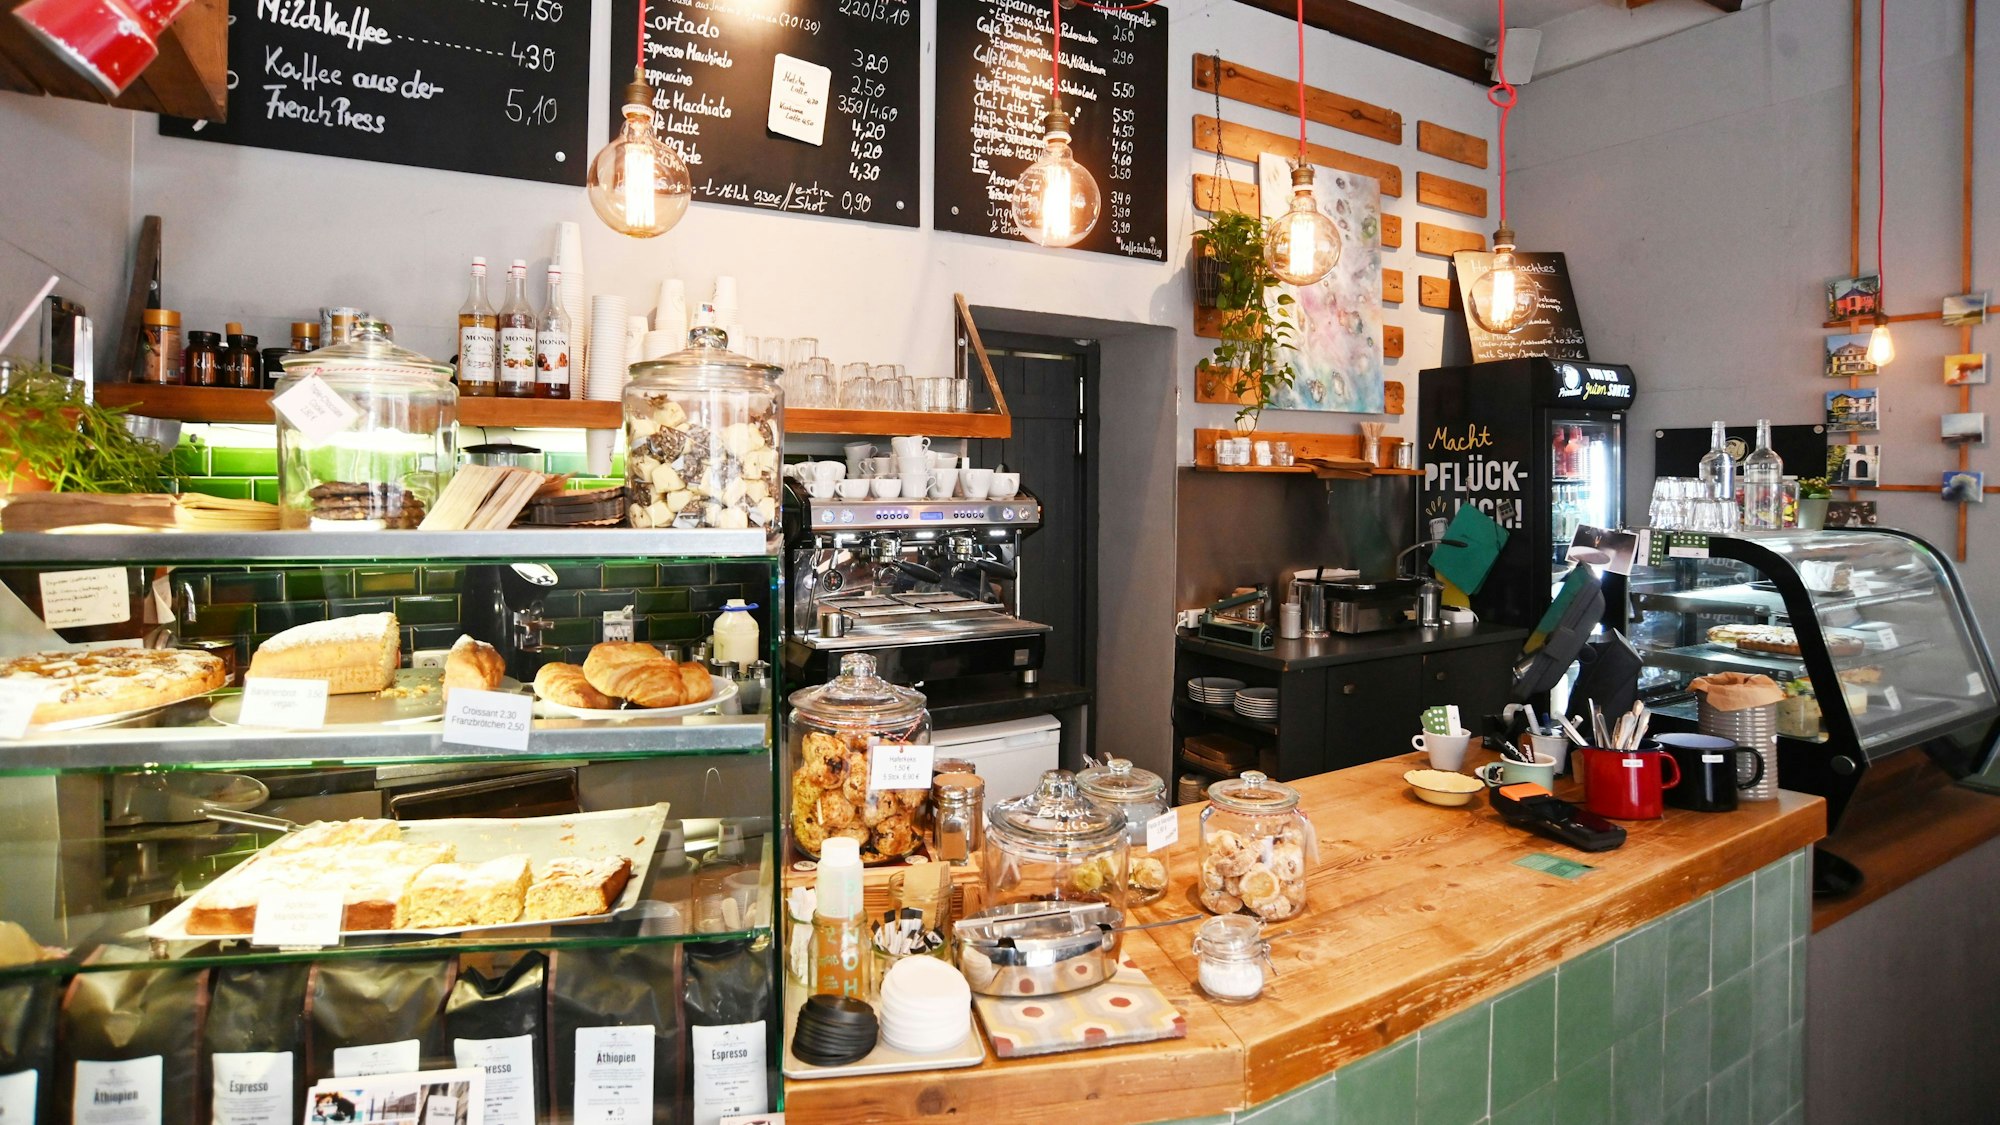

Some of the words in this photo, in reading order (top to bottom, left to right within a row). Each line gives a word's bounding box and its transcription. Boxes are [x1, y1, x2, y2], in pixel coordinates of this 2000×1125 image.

[264, 45, 343, 91] Kaffee
[352, 72, 399, 93] aus
[973, 92, 998, 110] Chai
[1000, 95, 1030, 115] Latte
[667, 113, 700, 136] Latte
[850, 140, 883, 159] 4,20
[852, 118, 886, 140] 4,20
[970, 152, 990, 170] Tee
[849, 162, 881, 182] 4,30
[465, 333, 495, 343] MONIN
[505, 334, 534, 343] MONIN
[539, 338, 567, 347] MONIN
[1428, 423, 1493, 451] Macht
[1424, 454, 1528, 492] PFLÜCK-
[462, 705, 499, 718] Croissant
[500, 710, 517, 720] 2.30
[451, 715, 506, 730] Franzbrötchen
[507, 722, 525, 732] 2.50
[711, 1048, 748, 1061] Espresso
[229, 1080, 269, 1095] Espresso
